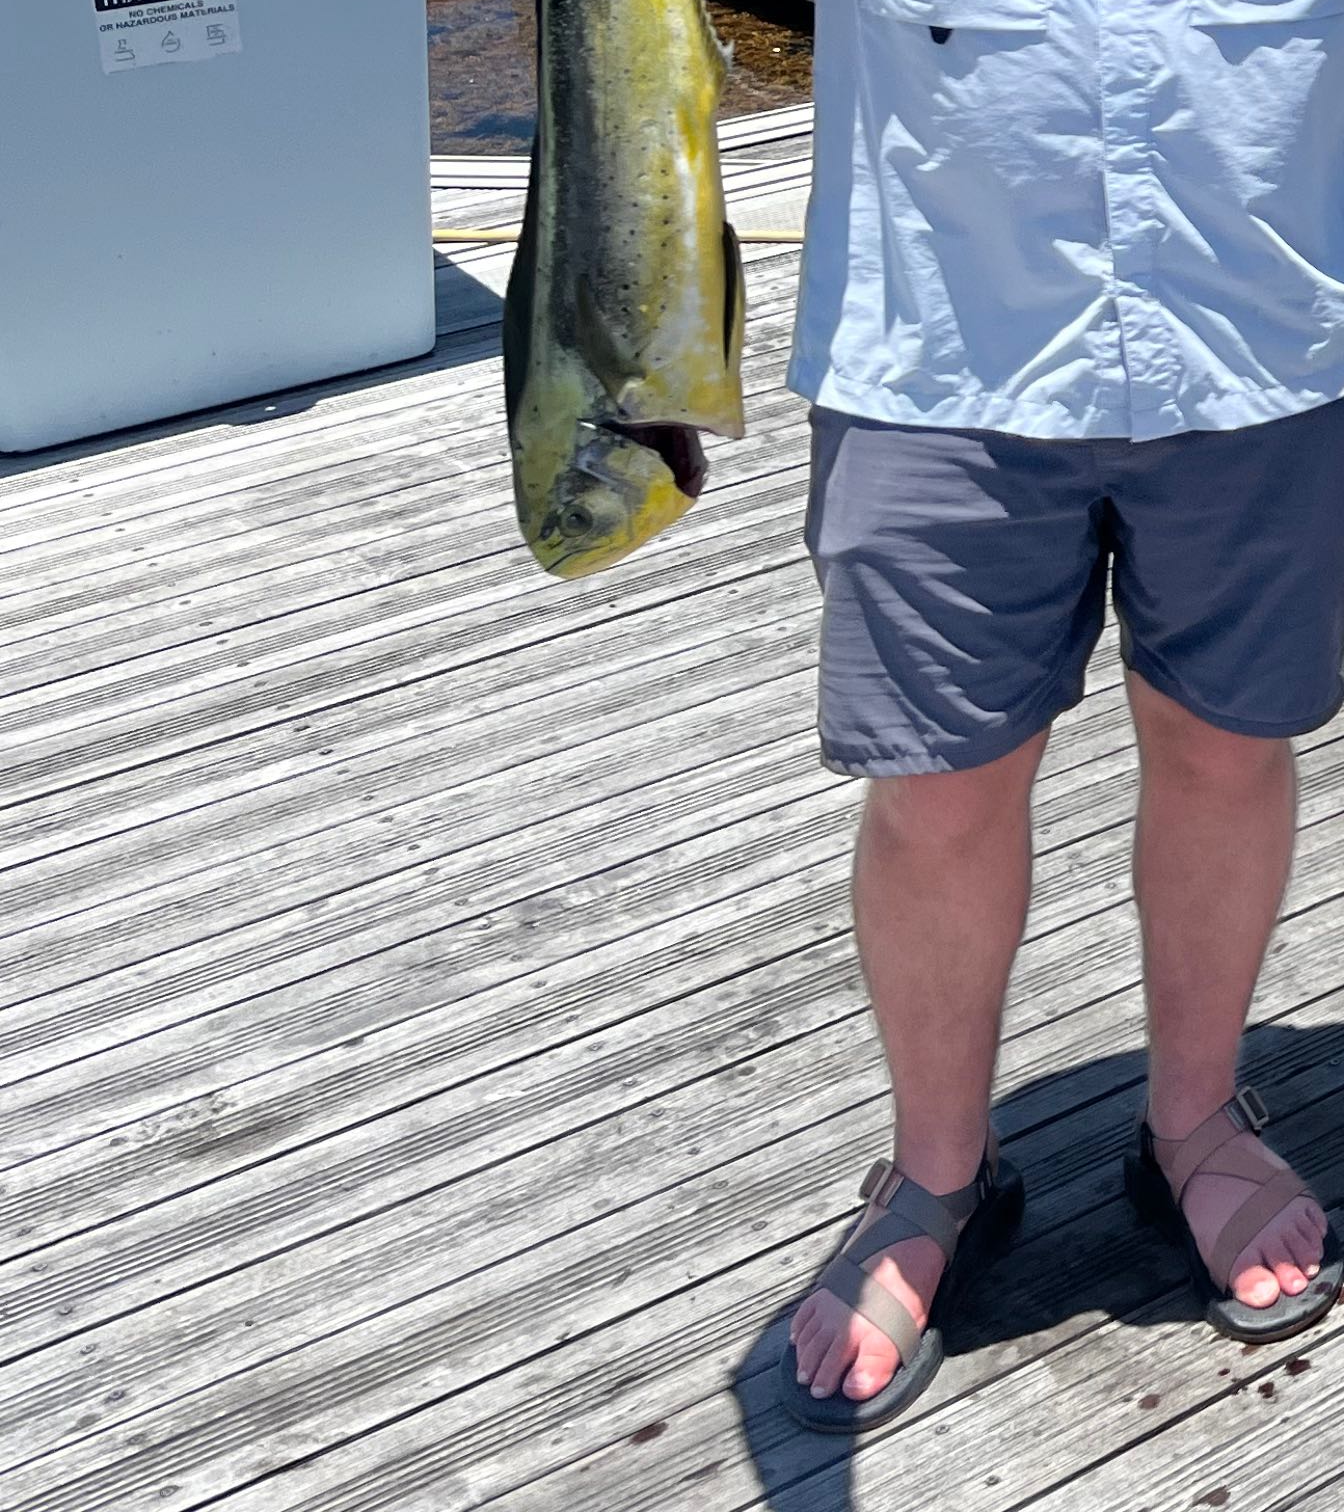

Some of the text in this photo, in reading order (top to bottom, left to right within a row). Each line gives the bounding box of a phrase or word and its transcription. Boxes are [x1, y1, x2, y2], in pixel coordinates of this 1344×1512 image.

[99, 4, 235, 32] OR HAZARDOUS MATERIALS
[129, 0, 204, 18] NO CHEMICALS
